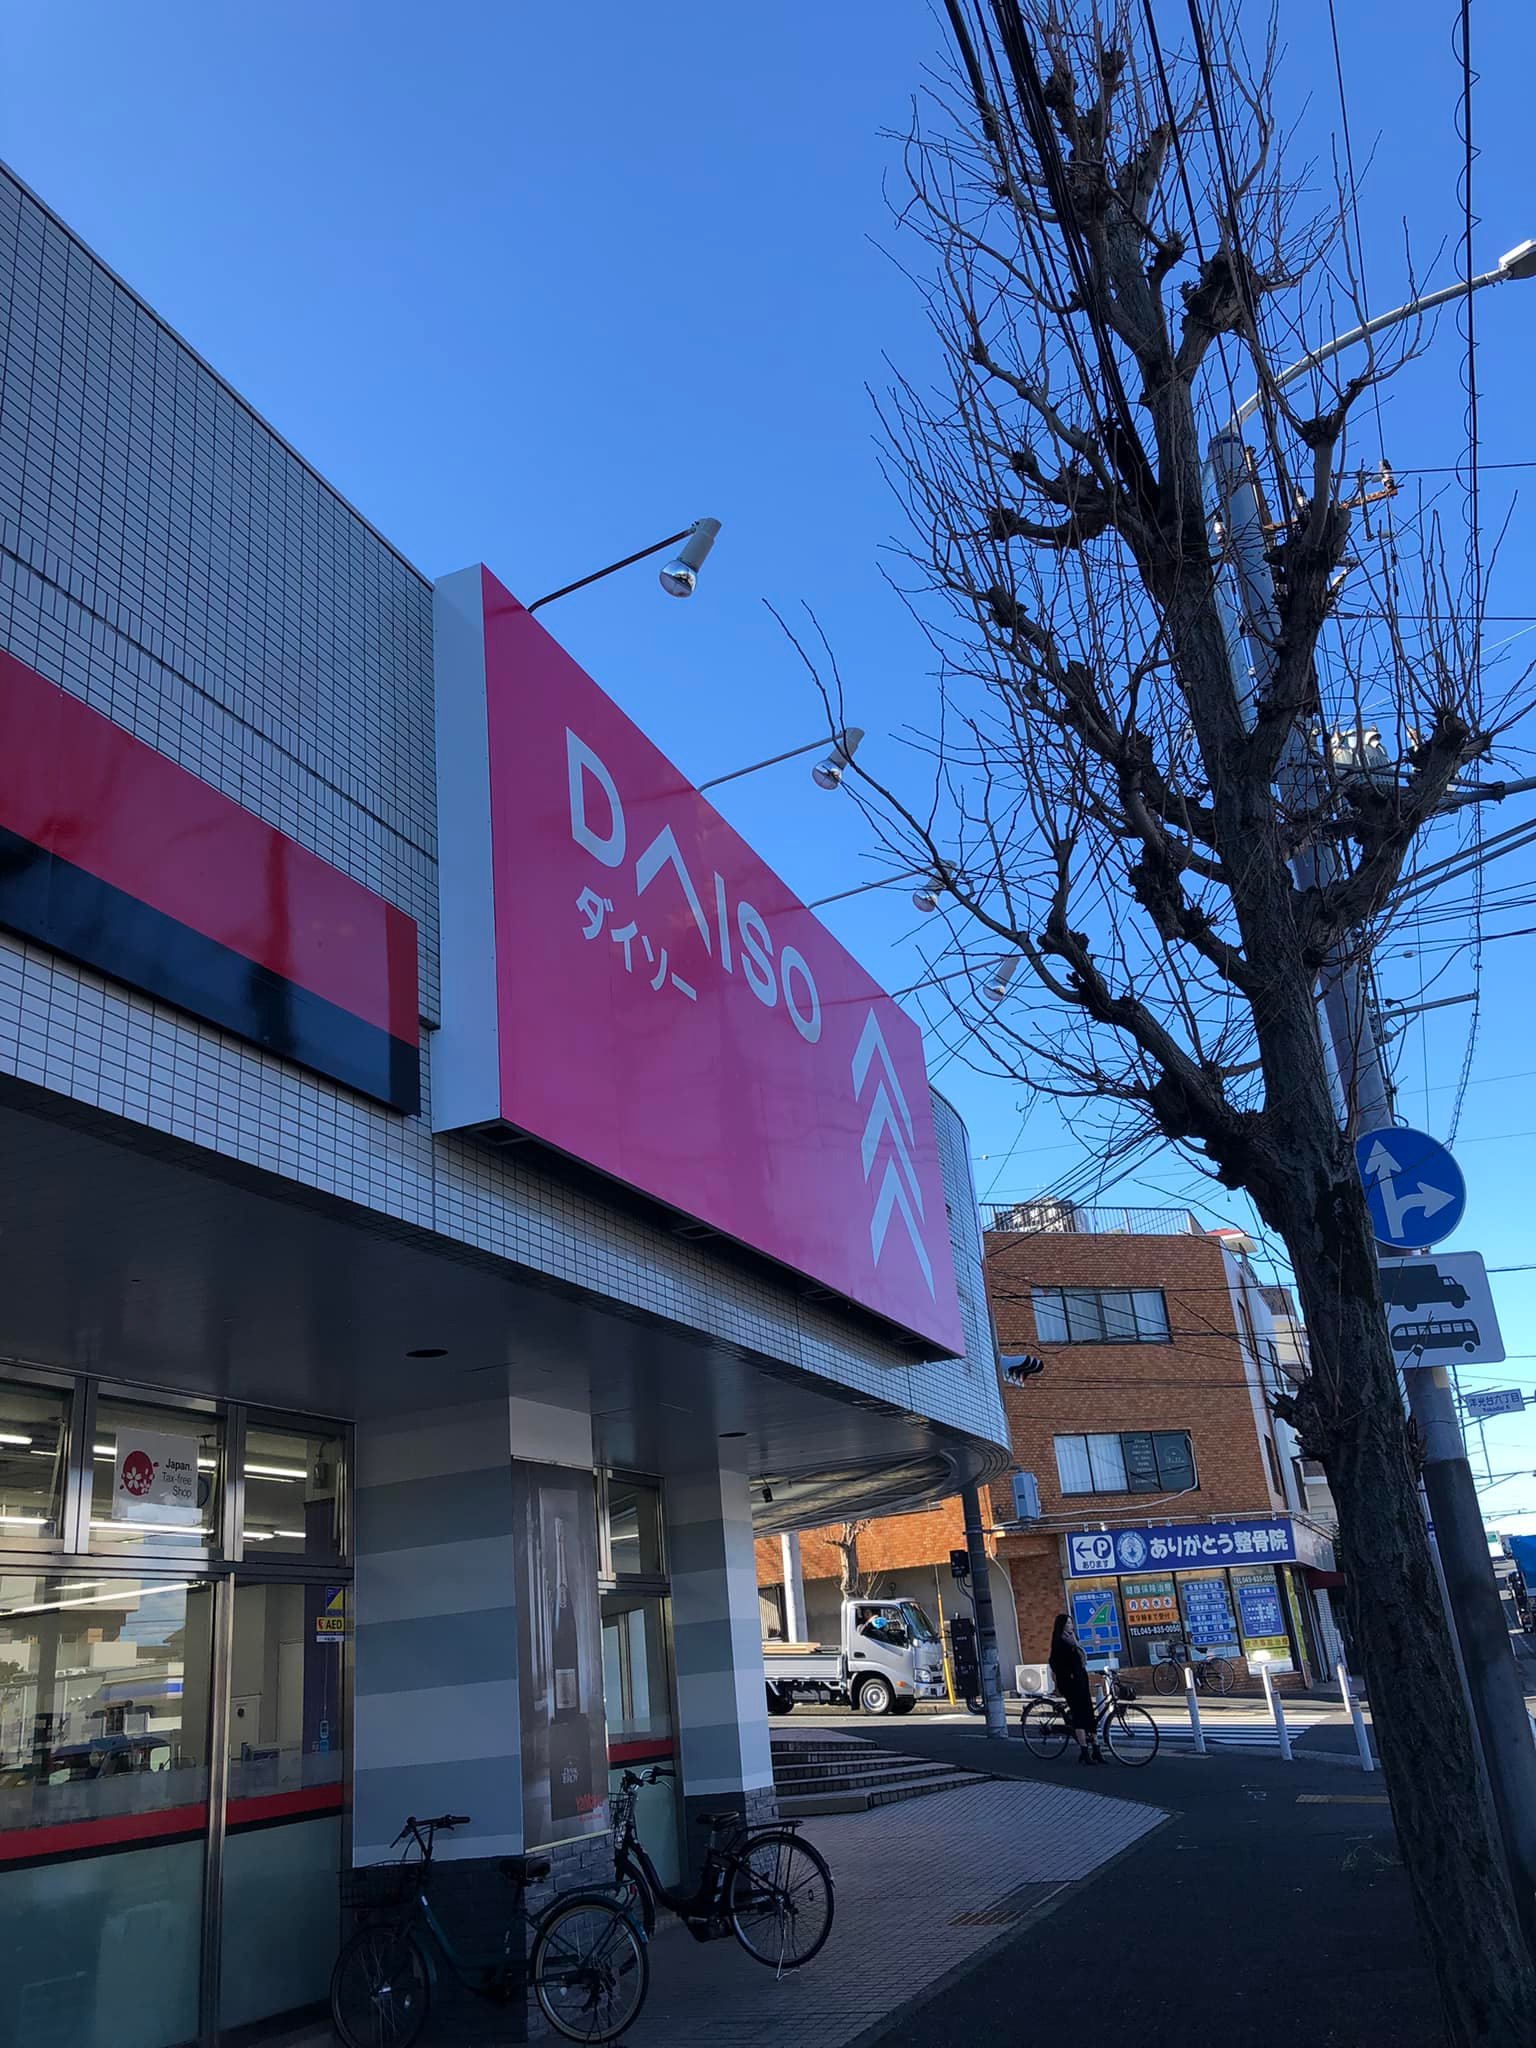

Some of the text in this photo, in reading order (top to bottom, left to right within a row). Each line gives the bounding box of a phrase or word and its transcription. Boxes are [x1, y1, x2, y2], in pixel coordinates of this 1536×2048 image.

[565, 726, 823, 1044] DAISO
[575, 885, 697, 1003] ダイソー
[165, 1458, 193, 1472] Japan.
[162, 1471, 192, 1486] Tax-free
[172, 1485, 192, 1499] Shop
[1150, 1528, 1289, 1560] ありがとう整骨院
[1082, 1560, 1109, 1569] あります
[326, 1619, 342, 1630] AED
